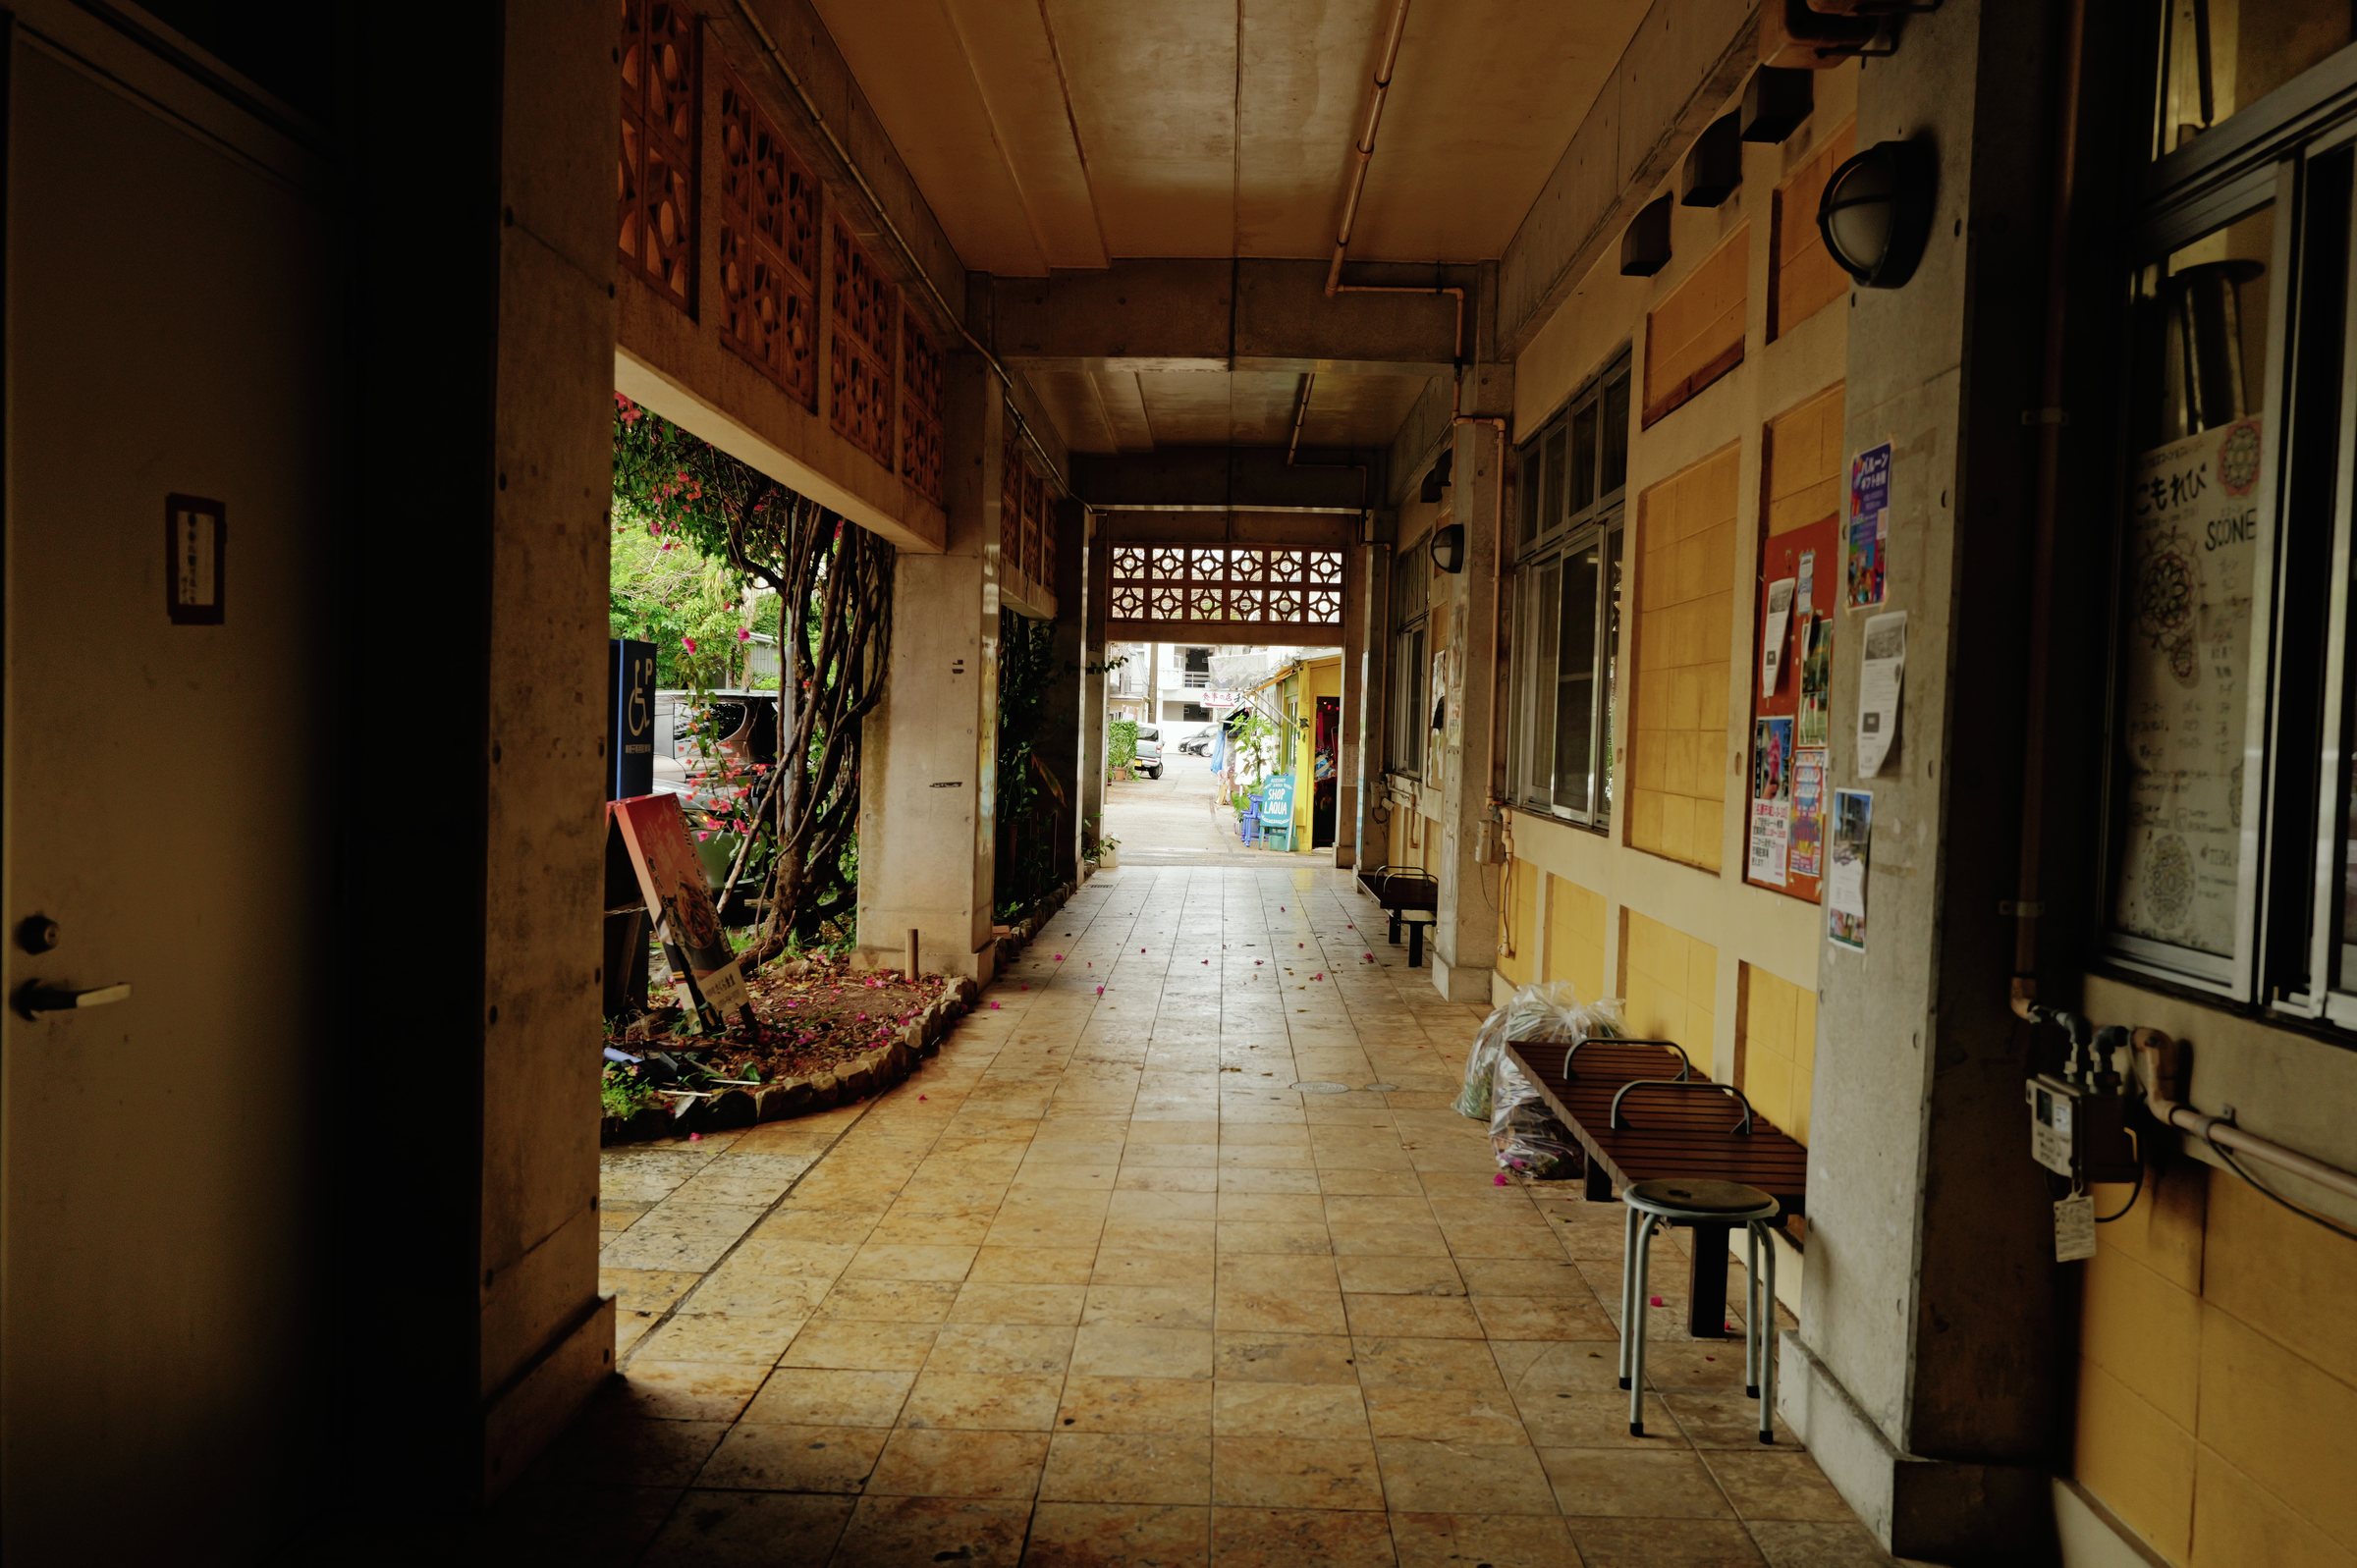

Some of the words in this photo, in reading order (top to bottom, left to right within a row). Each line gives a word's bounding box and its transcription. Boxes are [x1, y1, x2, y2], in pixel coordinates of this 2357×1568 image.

[644, 657, 653, 685] P
[1267, 787, 1286, 801] SHOP
[1263, 800, 1288, 816] LAQUA
